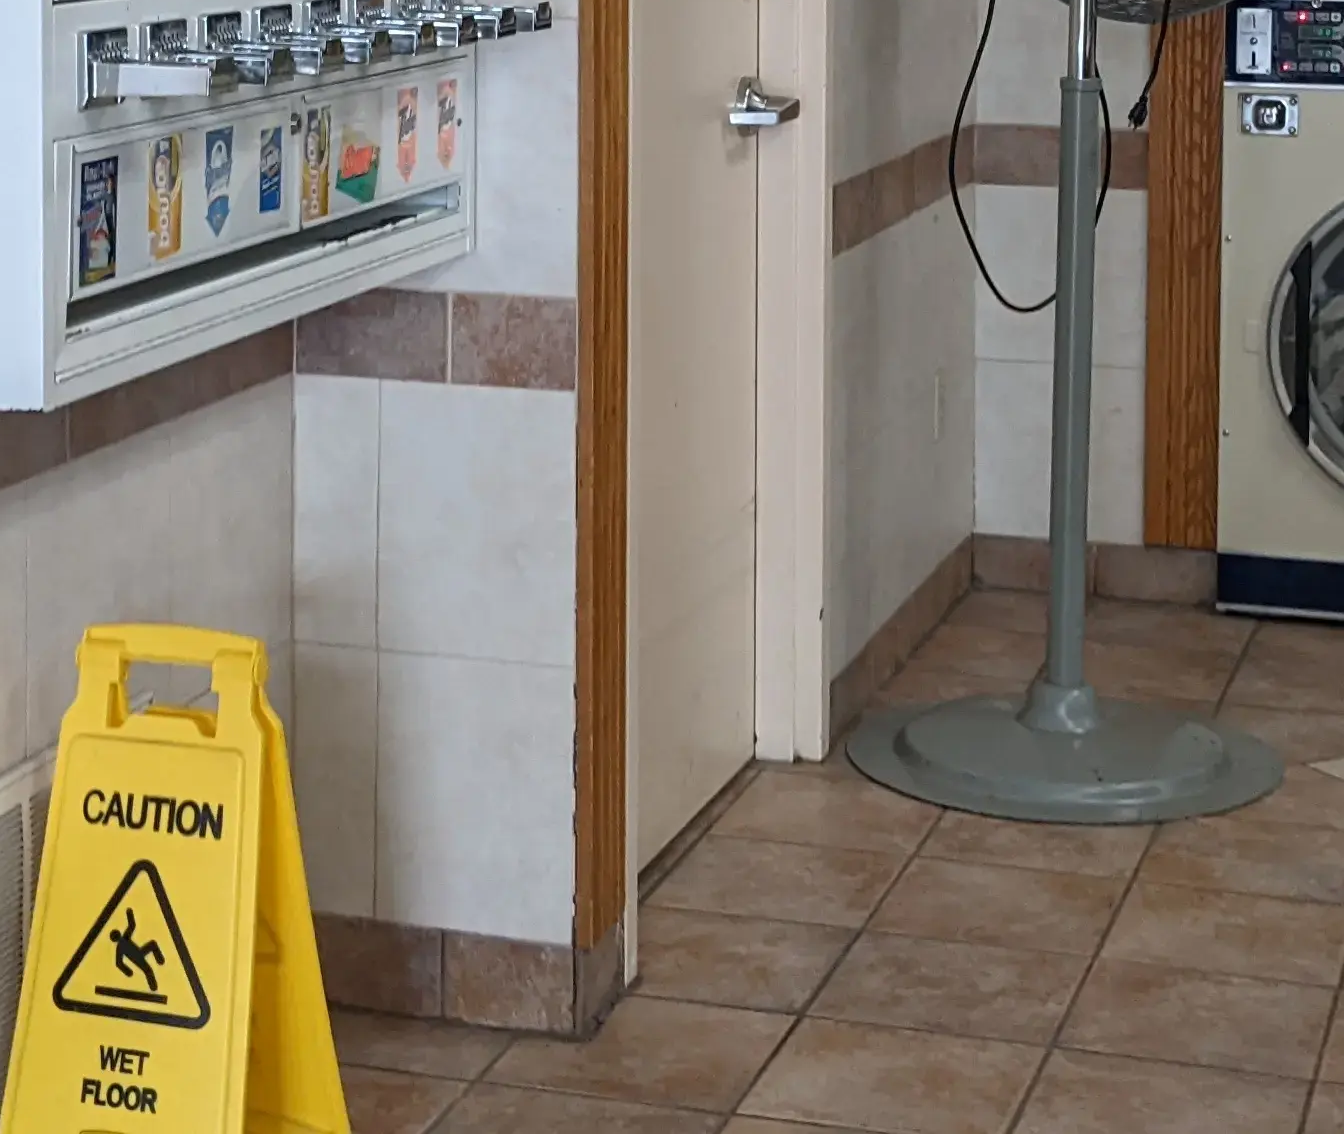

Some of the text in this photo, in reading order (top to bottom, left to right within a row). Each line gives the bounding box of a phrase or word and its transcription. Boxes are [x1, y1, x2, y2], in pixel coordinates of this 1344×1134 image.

[82, 788, 224, 841] CAUTION
[99, 1044, 150, 1077] WET
[80, 1077, 157, 1115] FLOOR
